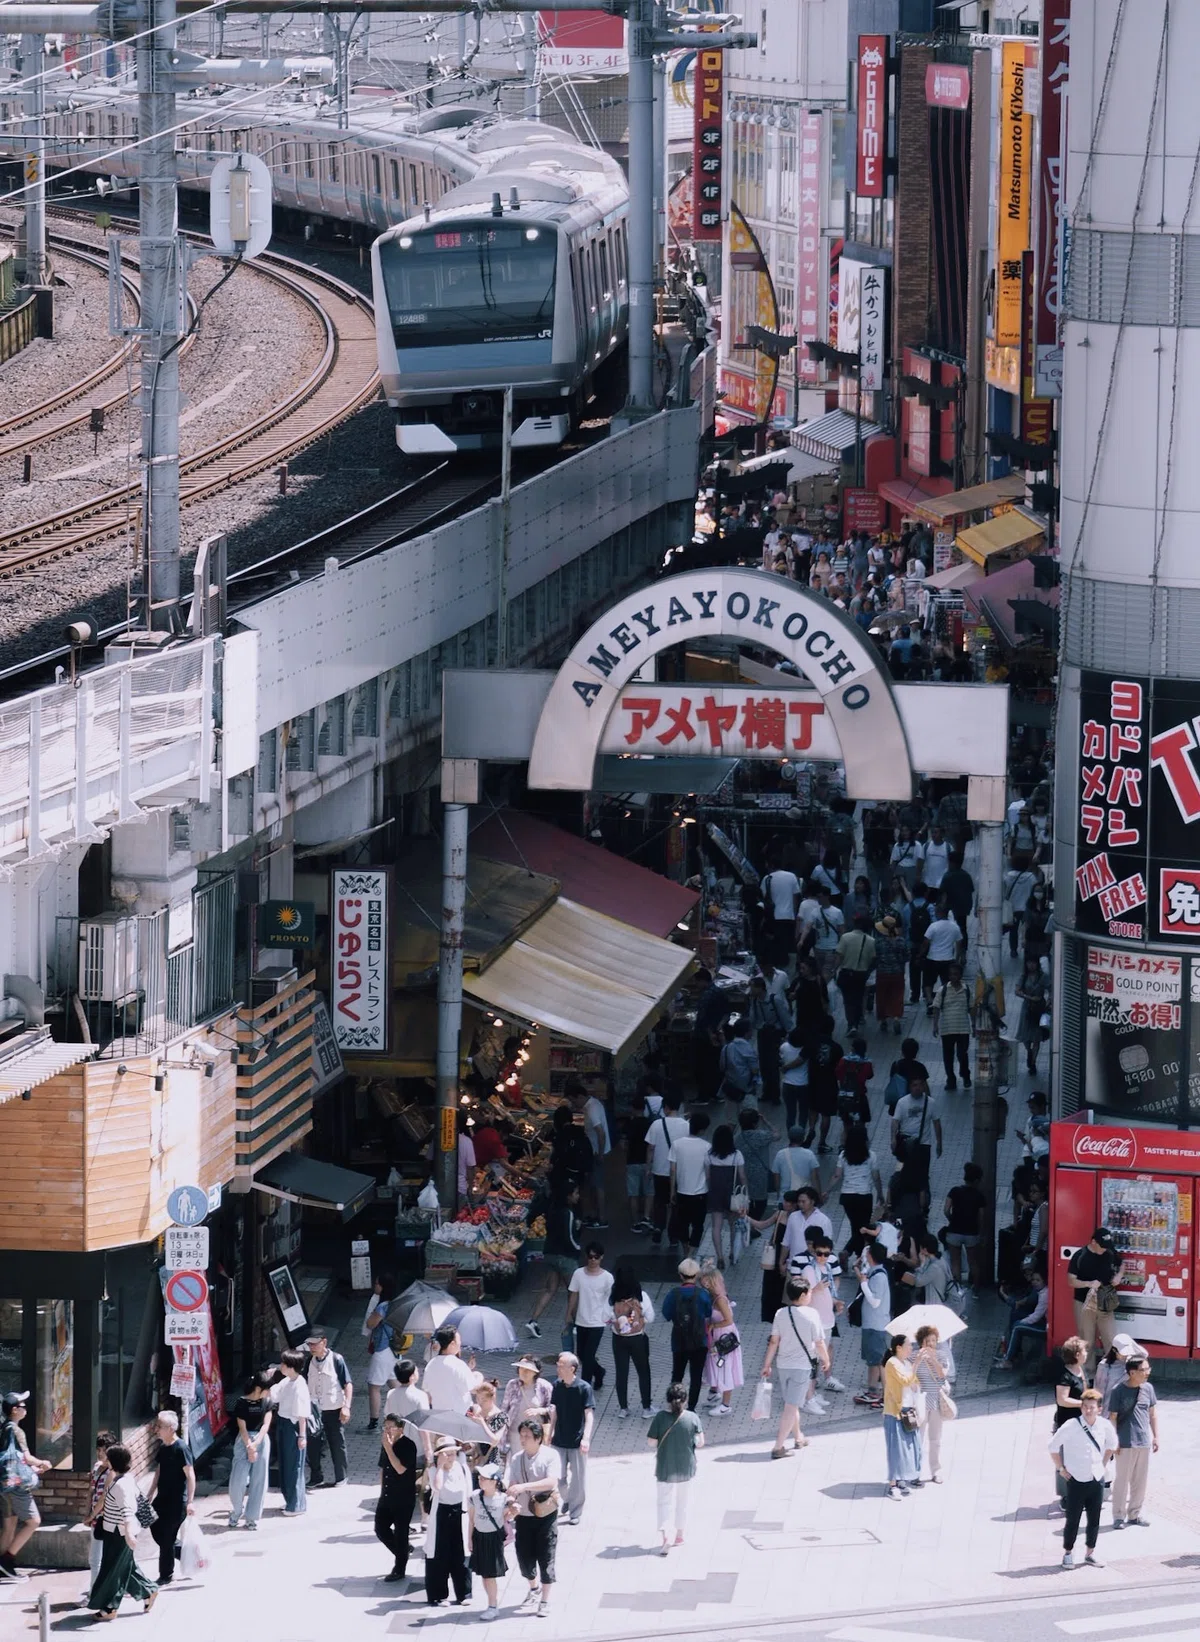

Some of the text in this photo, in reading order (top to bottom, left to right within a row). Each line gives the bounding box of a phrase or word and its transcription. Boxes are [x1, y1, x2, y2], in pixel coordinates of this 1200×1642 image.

[703, 132, 720, 143] 3F
[861, 70, 879, 186] GAME
[1008, 61, 1025, 220] Matsumoto KiYoshi
[703, 160, 720, 171] 2F
[703, 187, 719, 198] 1F
[702, 213, 719, 225] BF
[537, 329, 552, 338] JR
[572, 590, 871, 711] AMEYAYOKOCHO
[621, 695, 826, 750] アメヤ横丁
[1107, 680, 1143, 847] ヨドバシ
[1081, 719, 1106, 845] カメラ
[1076, 852, 1118, 902] TAX
[1097, 872, 1147, 922] FREE
[269, 934, 310, 943] PRONTO
[1108, 920, 1143, 939] STORE
[337, 898, 362, 1022] じゅらく
[1088, 950, 1181, 975] ヨドバシカメラ
[1116, 977, 1180, 993] GOLD POINT
[1124, 1061, 1180, 1086] 4980 00
[1076, 1135, 1133, 1158] Coca-Cola
[1143, 1147, 1165, 1155] TASTE
[1165, 1148, 1179, 1156] THE
